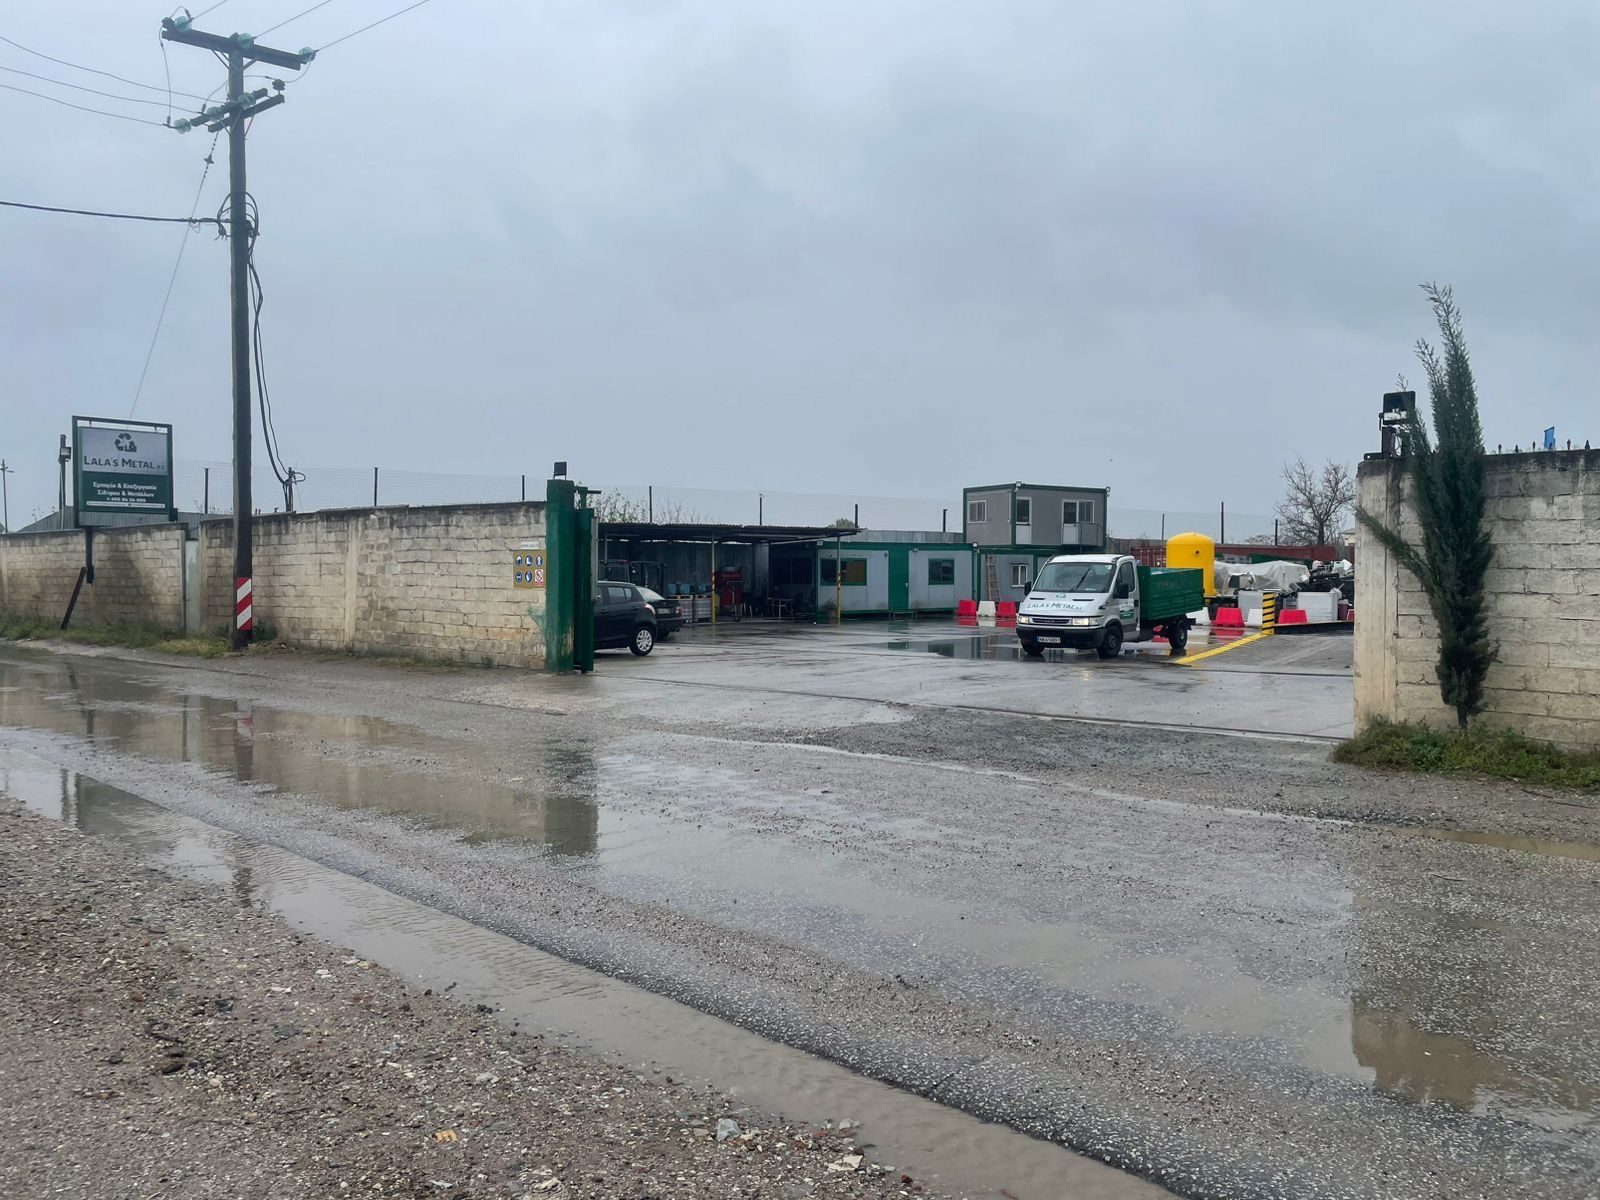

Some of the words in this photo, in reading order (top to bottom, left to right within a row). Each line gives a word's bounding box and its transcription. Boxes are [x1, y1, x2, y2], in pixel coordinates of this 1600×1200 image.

[84, 456, 118, 466] LALA'S
[121, 458, 154, 469] METAL
[1050, 602, 1075, 610] METAL
